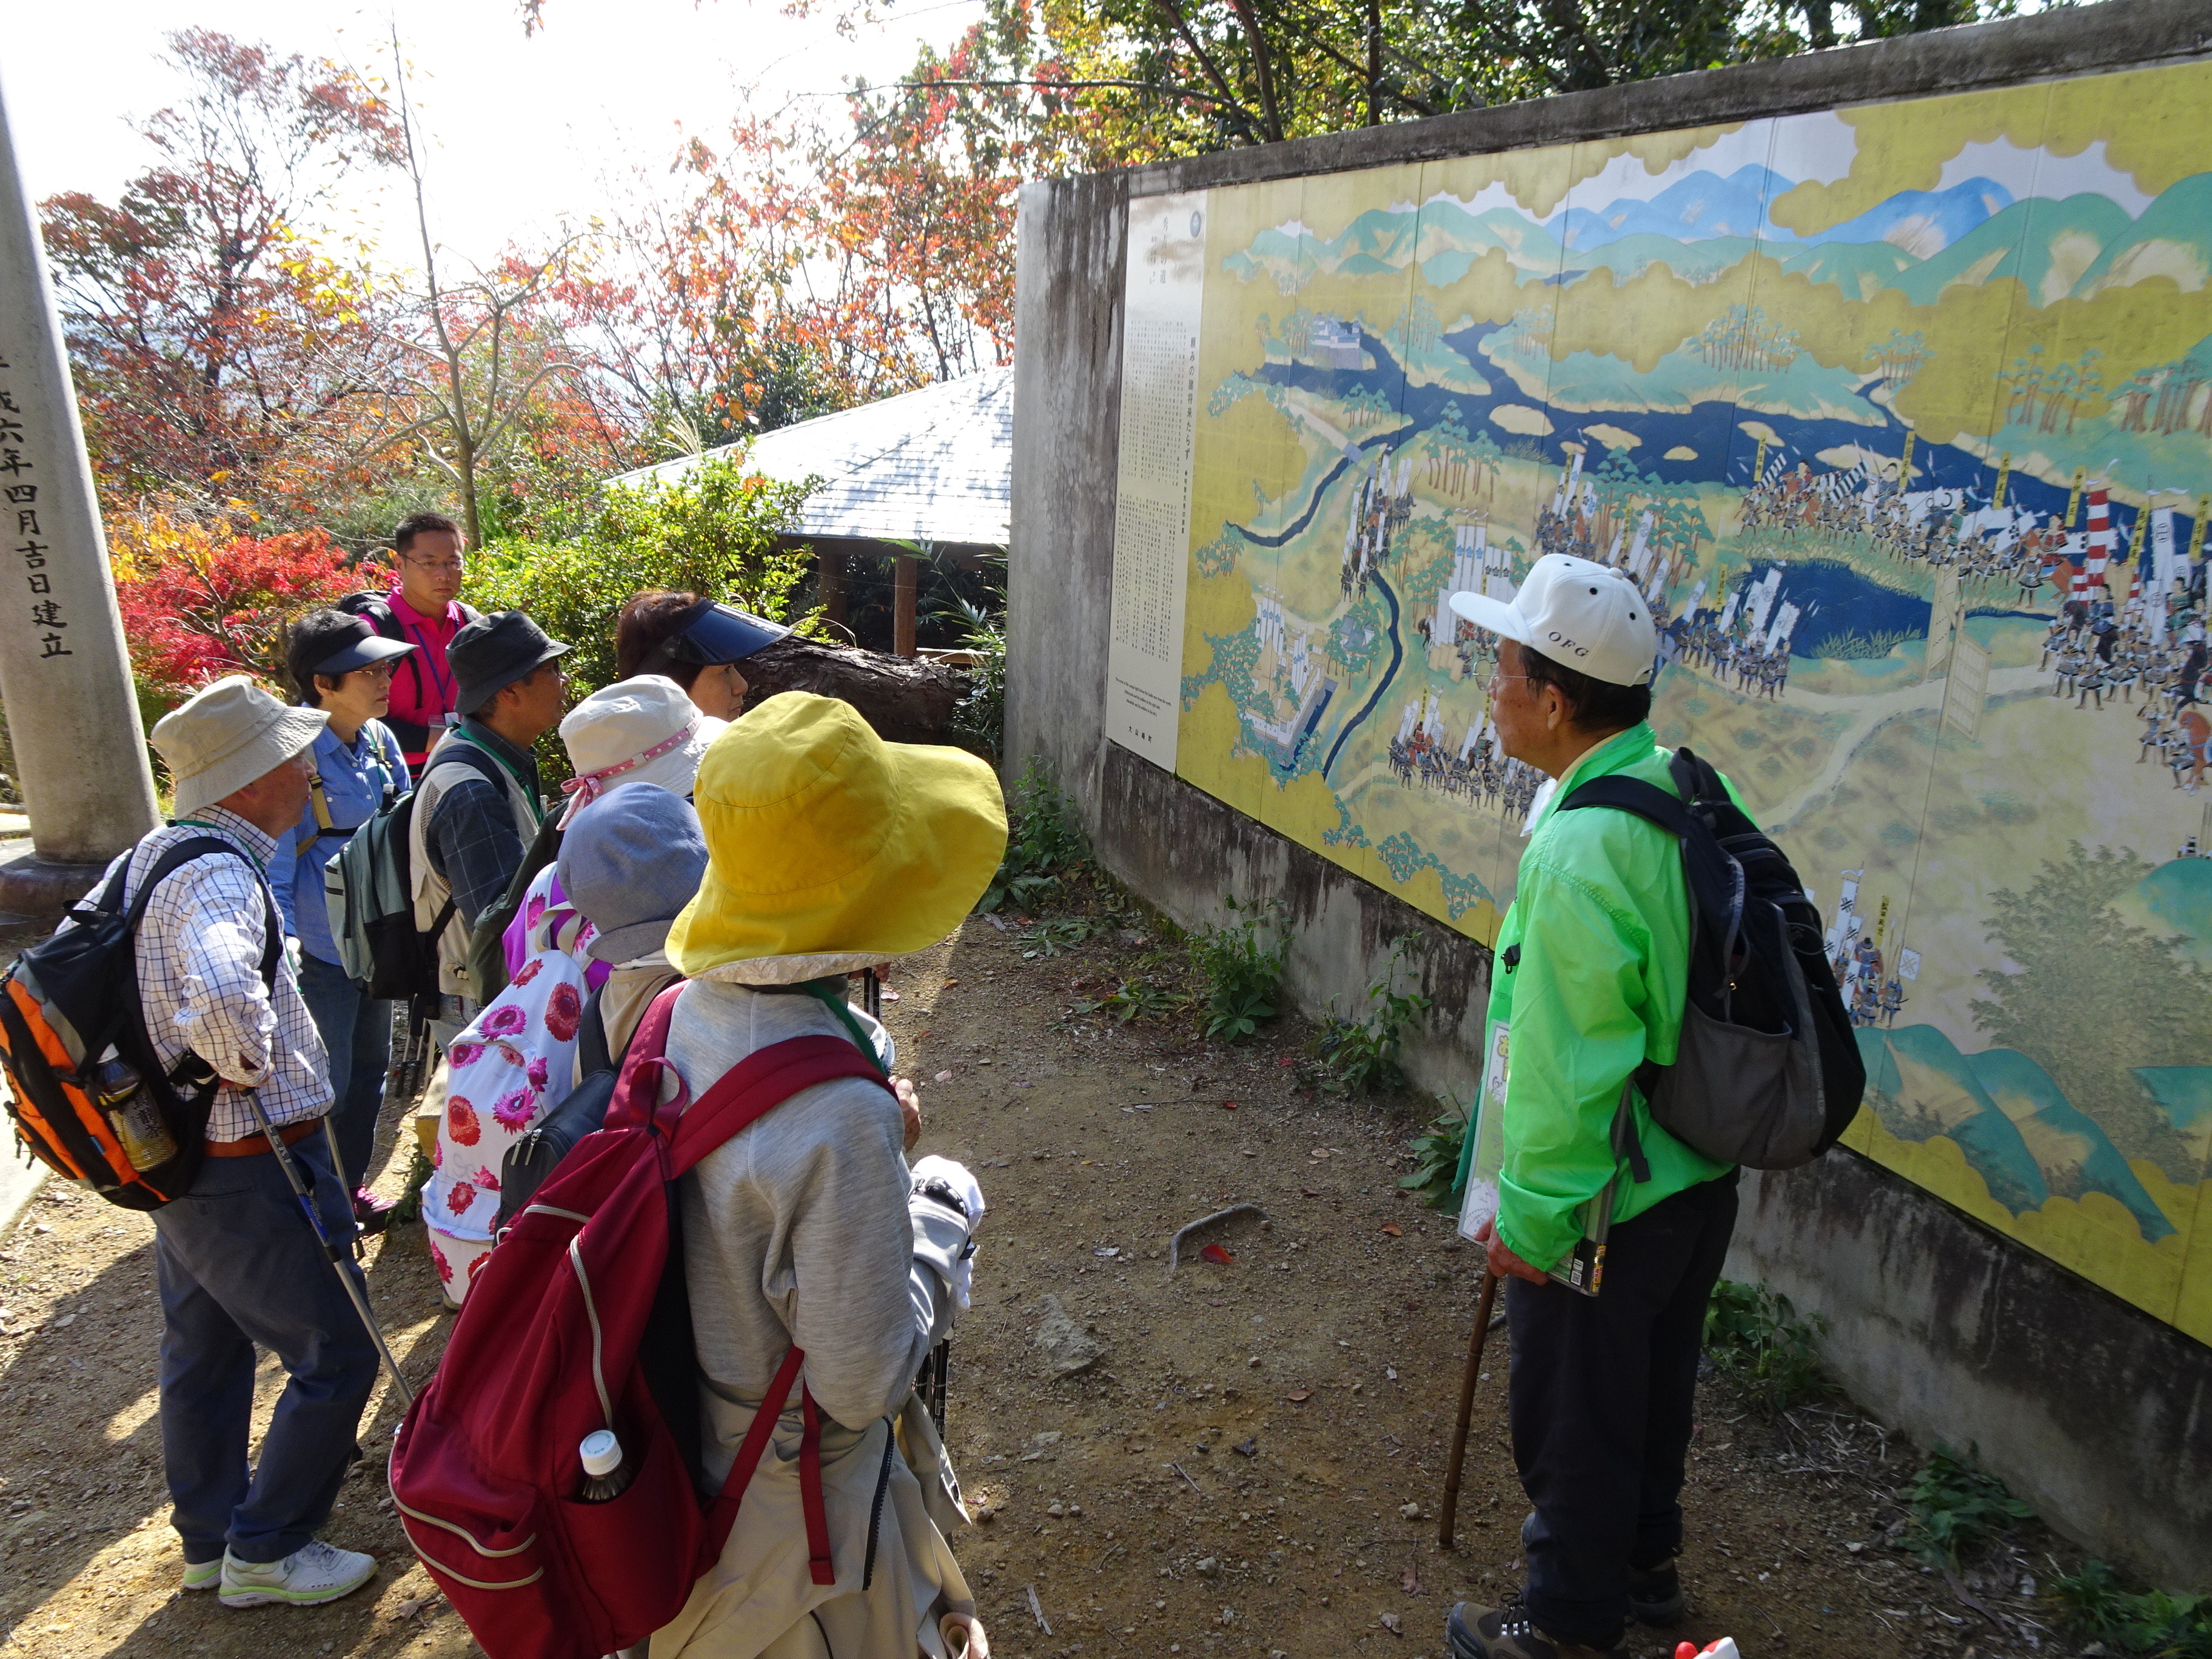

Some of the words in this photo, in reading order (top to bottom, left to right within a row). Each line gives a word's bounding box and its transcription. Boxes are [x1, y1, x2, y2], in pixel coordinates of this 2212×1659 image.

[1160, 216, 1169, 284] 秀吉の道
[1185, 337, 1196, 460] 頼みの諸将来たらず
[1548, 631, 1590, 657] OFG
[266, 1124, 292, 1164] LEKI
